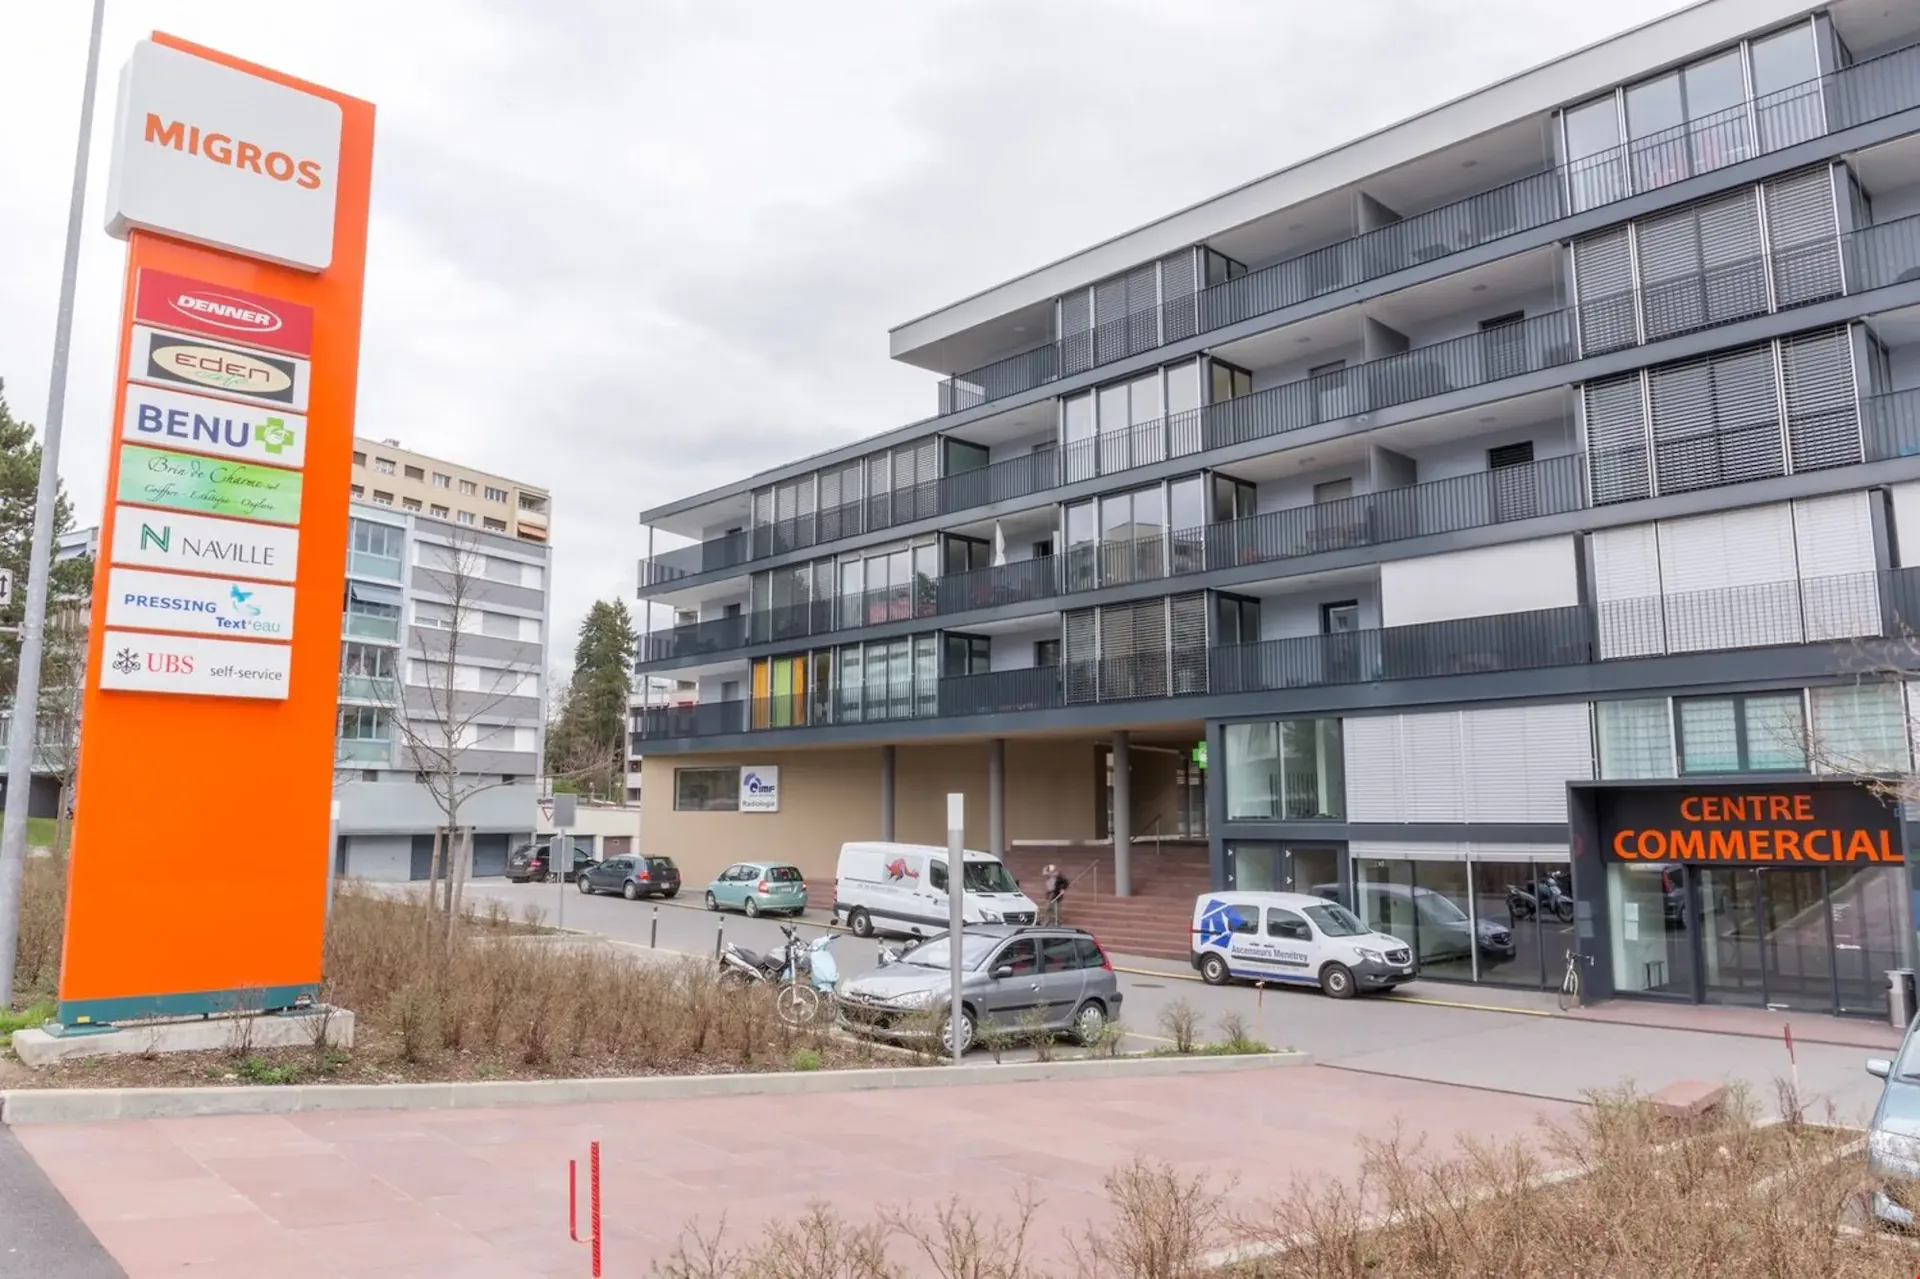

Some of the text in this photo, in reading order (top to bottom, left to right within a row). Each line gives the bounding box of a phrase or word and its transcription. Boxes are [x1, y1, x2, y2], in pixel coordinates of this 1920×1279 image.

[145, 112, 322, 190] MIGROS
[176, 294, 271, 326] DENNER
[138, 403, 250, 448] BENU
[181, 537, 275, 566] NAVILLE
[124, 593, 217, 614] PRESSING
[146, 652, 283, 682] UBS self-service
[1680, 794, 1815, 822] CENTRE
[1613, 828, 1905, 862] COMMERCIAL
